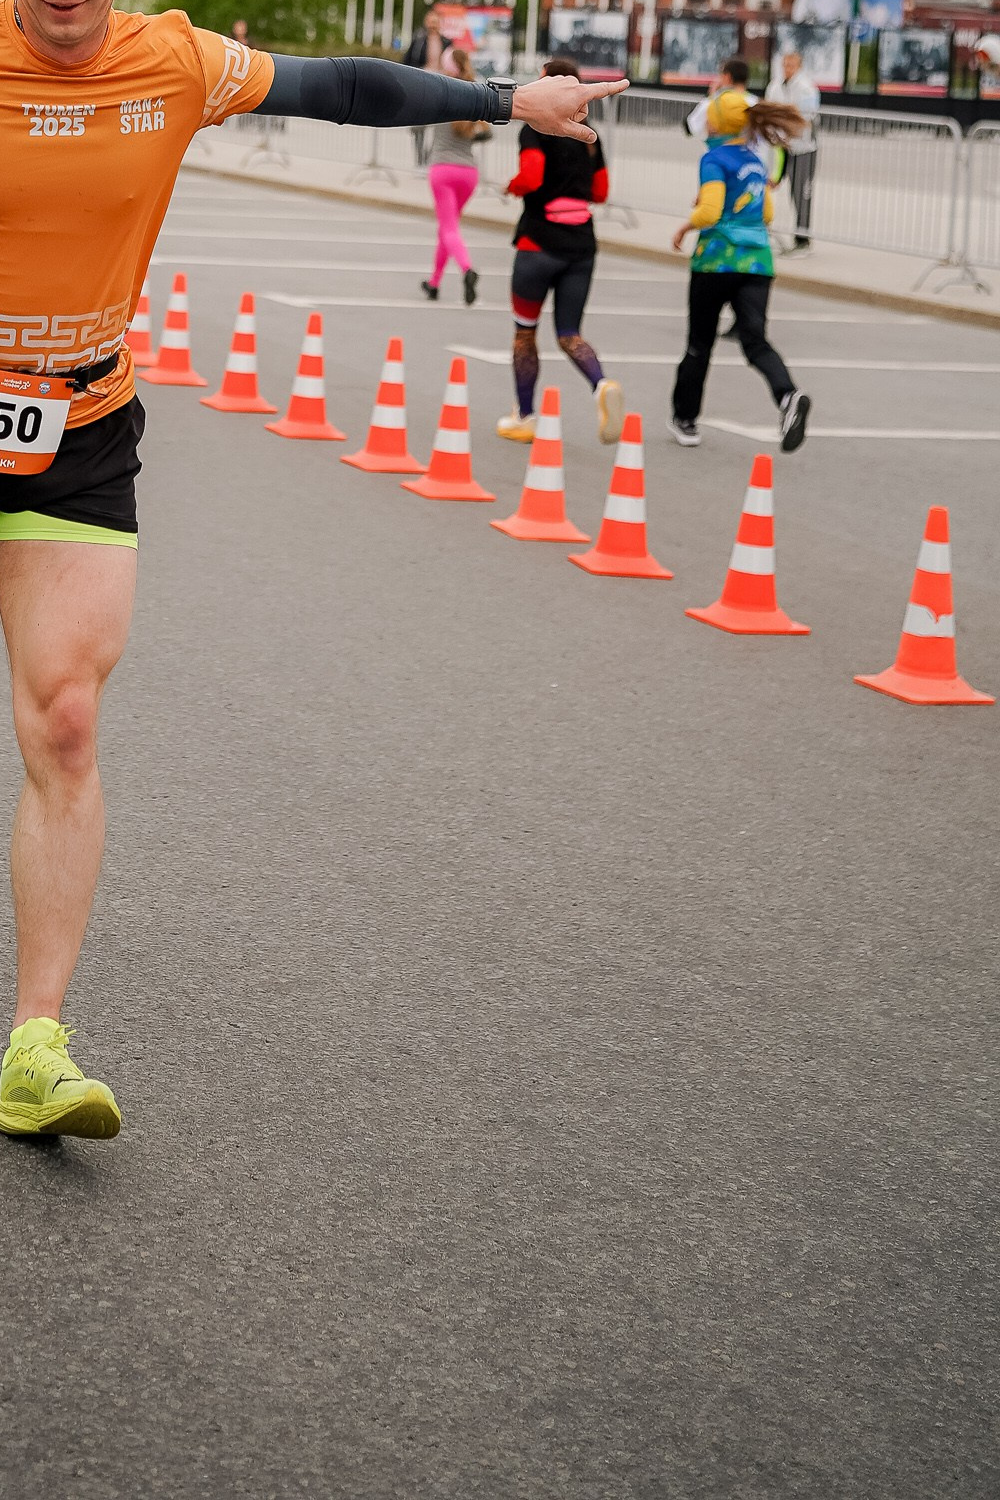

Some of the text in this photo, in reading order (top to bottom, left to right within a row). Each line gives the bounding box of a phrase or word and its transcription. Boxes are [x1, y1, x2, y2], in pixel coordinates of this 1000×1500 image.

[21, 103, 96, 116] TYUMEN
[119, 98, 152, 114] MAN
[29, 117, 86, 137] 2025
[119, 111, 165, 134] STAR
